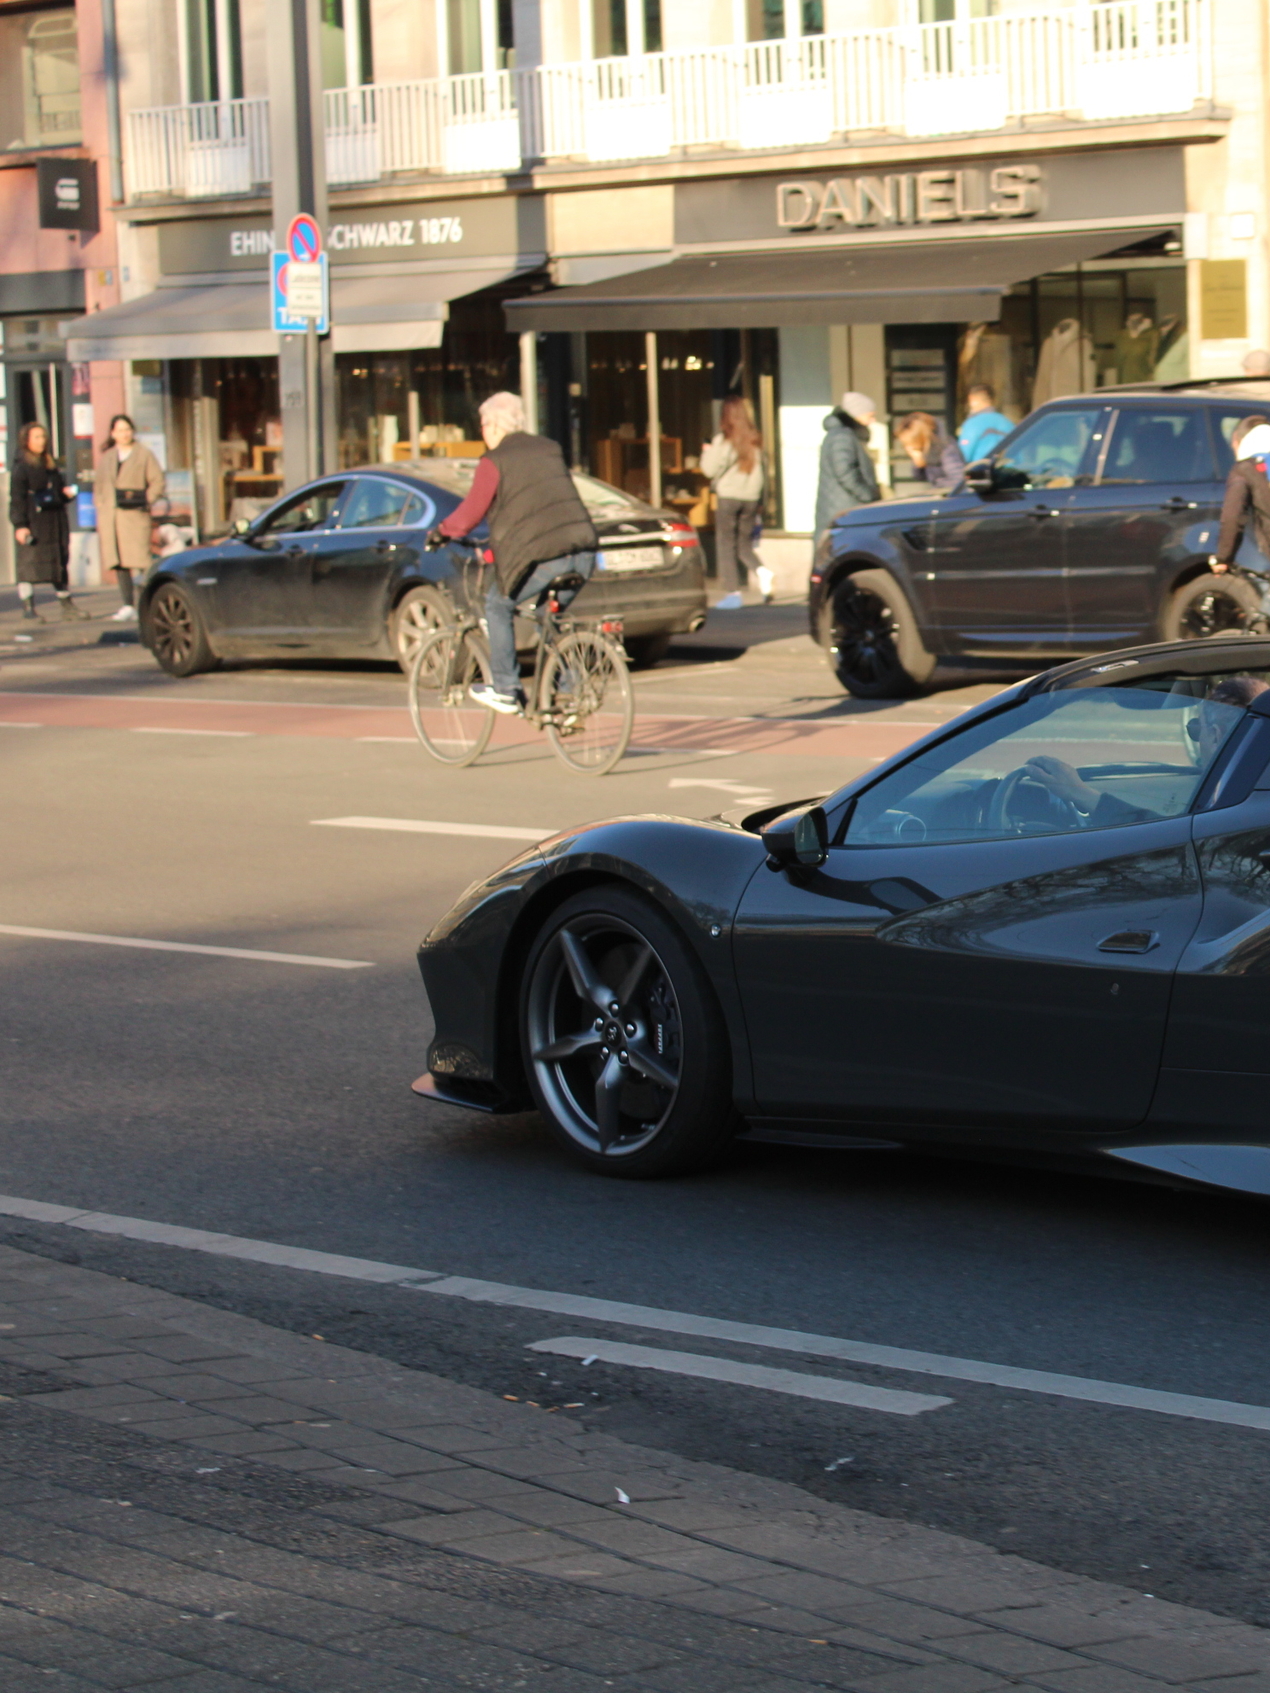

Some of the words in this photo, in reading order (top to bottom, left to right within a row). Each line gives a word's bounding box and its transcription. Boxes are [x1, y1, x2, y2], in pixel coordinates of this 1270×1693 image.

[776, 165, 1038, 229] DANIELS
[230, 231, 277, 256] EHIN
[419, 217, 463, 245] 1876
